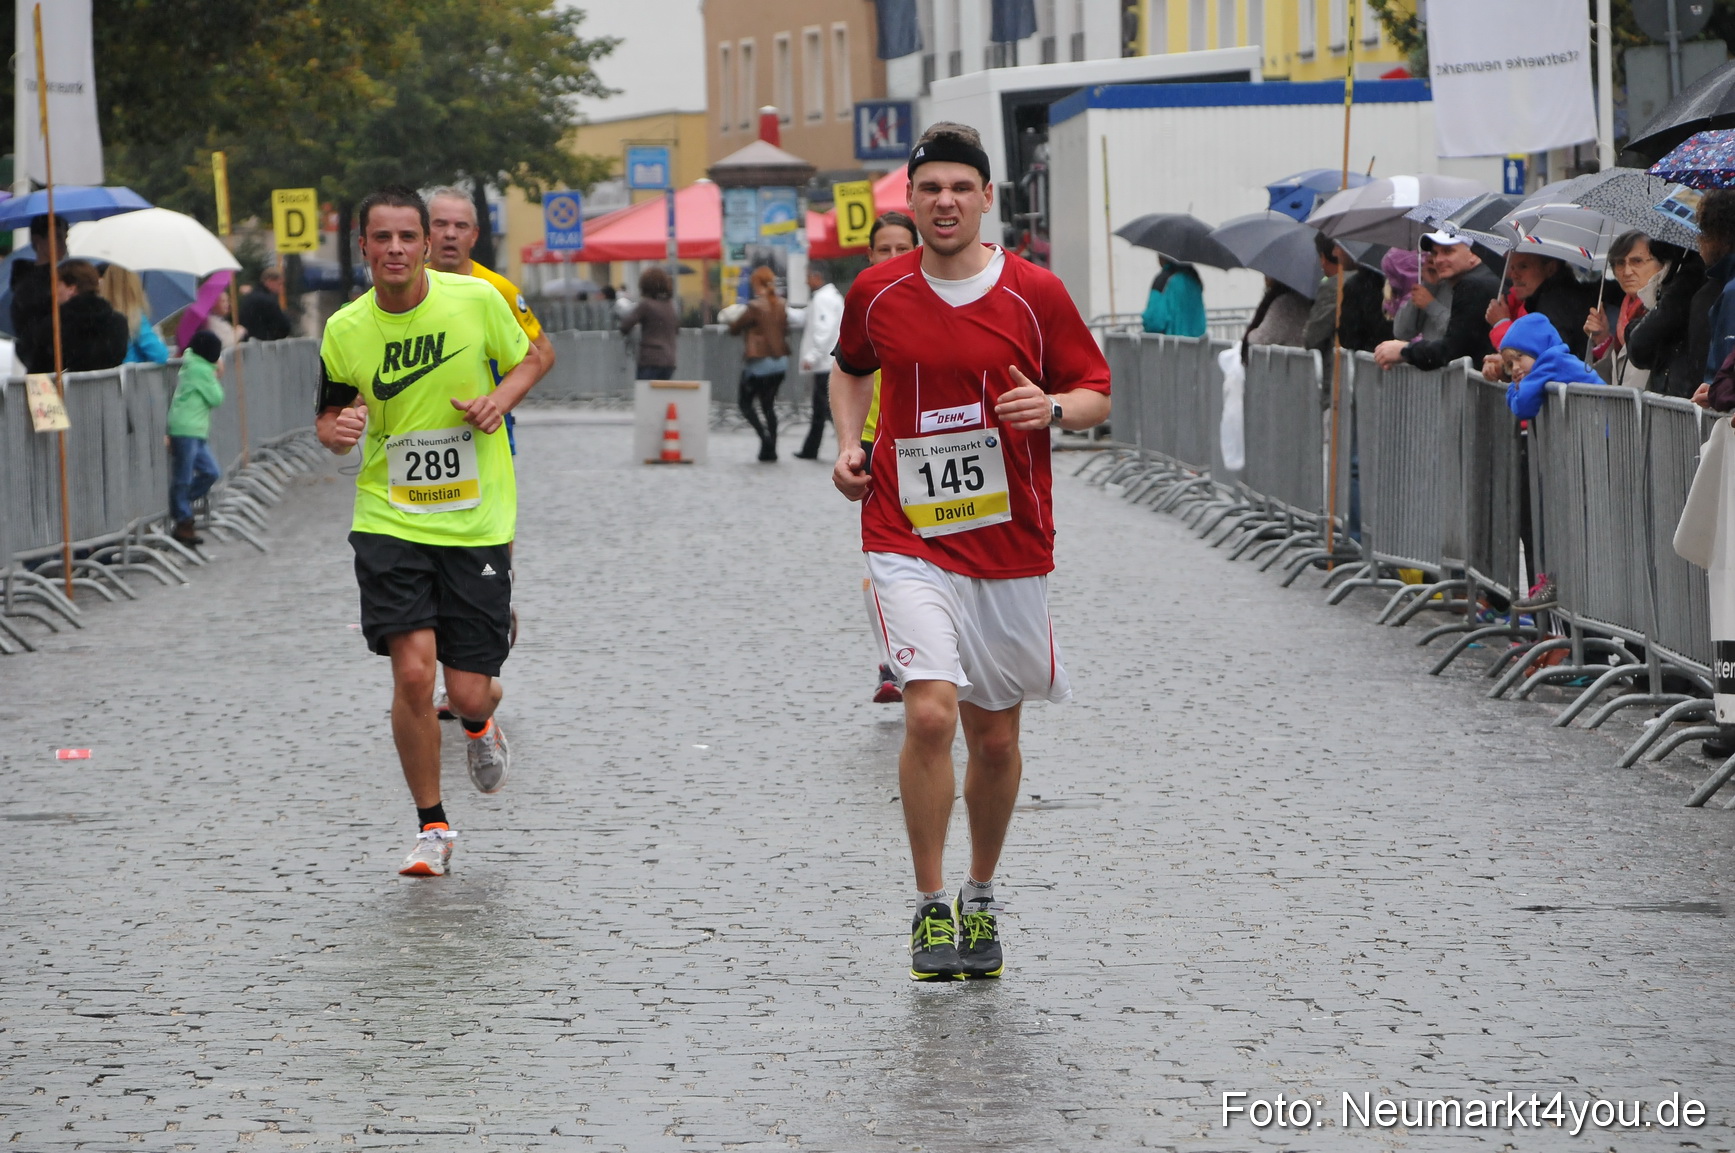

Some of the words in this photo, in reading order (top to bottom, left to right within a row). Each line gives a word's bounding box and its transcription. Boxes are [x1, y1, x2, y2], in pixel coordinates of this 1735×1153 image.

[285, 208, 305, 238] D
[848, 202, 867, 231] D
[382, 331, 446, 374] RUN
[937, 412, 964, 424] DEHN
[386, 438, 416, 450] PARTL
[417, 434, 459, 447] Neumarkt
[898, 447, 928, 458] PARTL
[930, 440, 981, 455] Neumarkt
[405, 448, 460, 481] 289
[918, 455, 984, 497] 145
[408, 487, 461, 502] Christian
[936, 502, 974, 521] David
